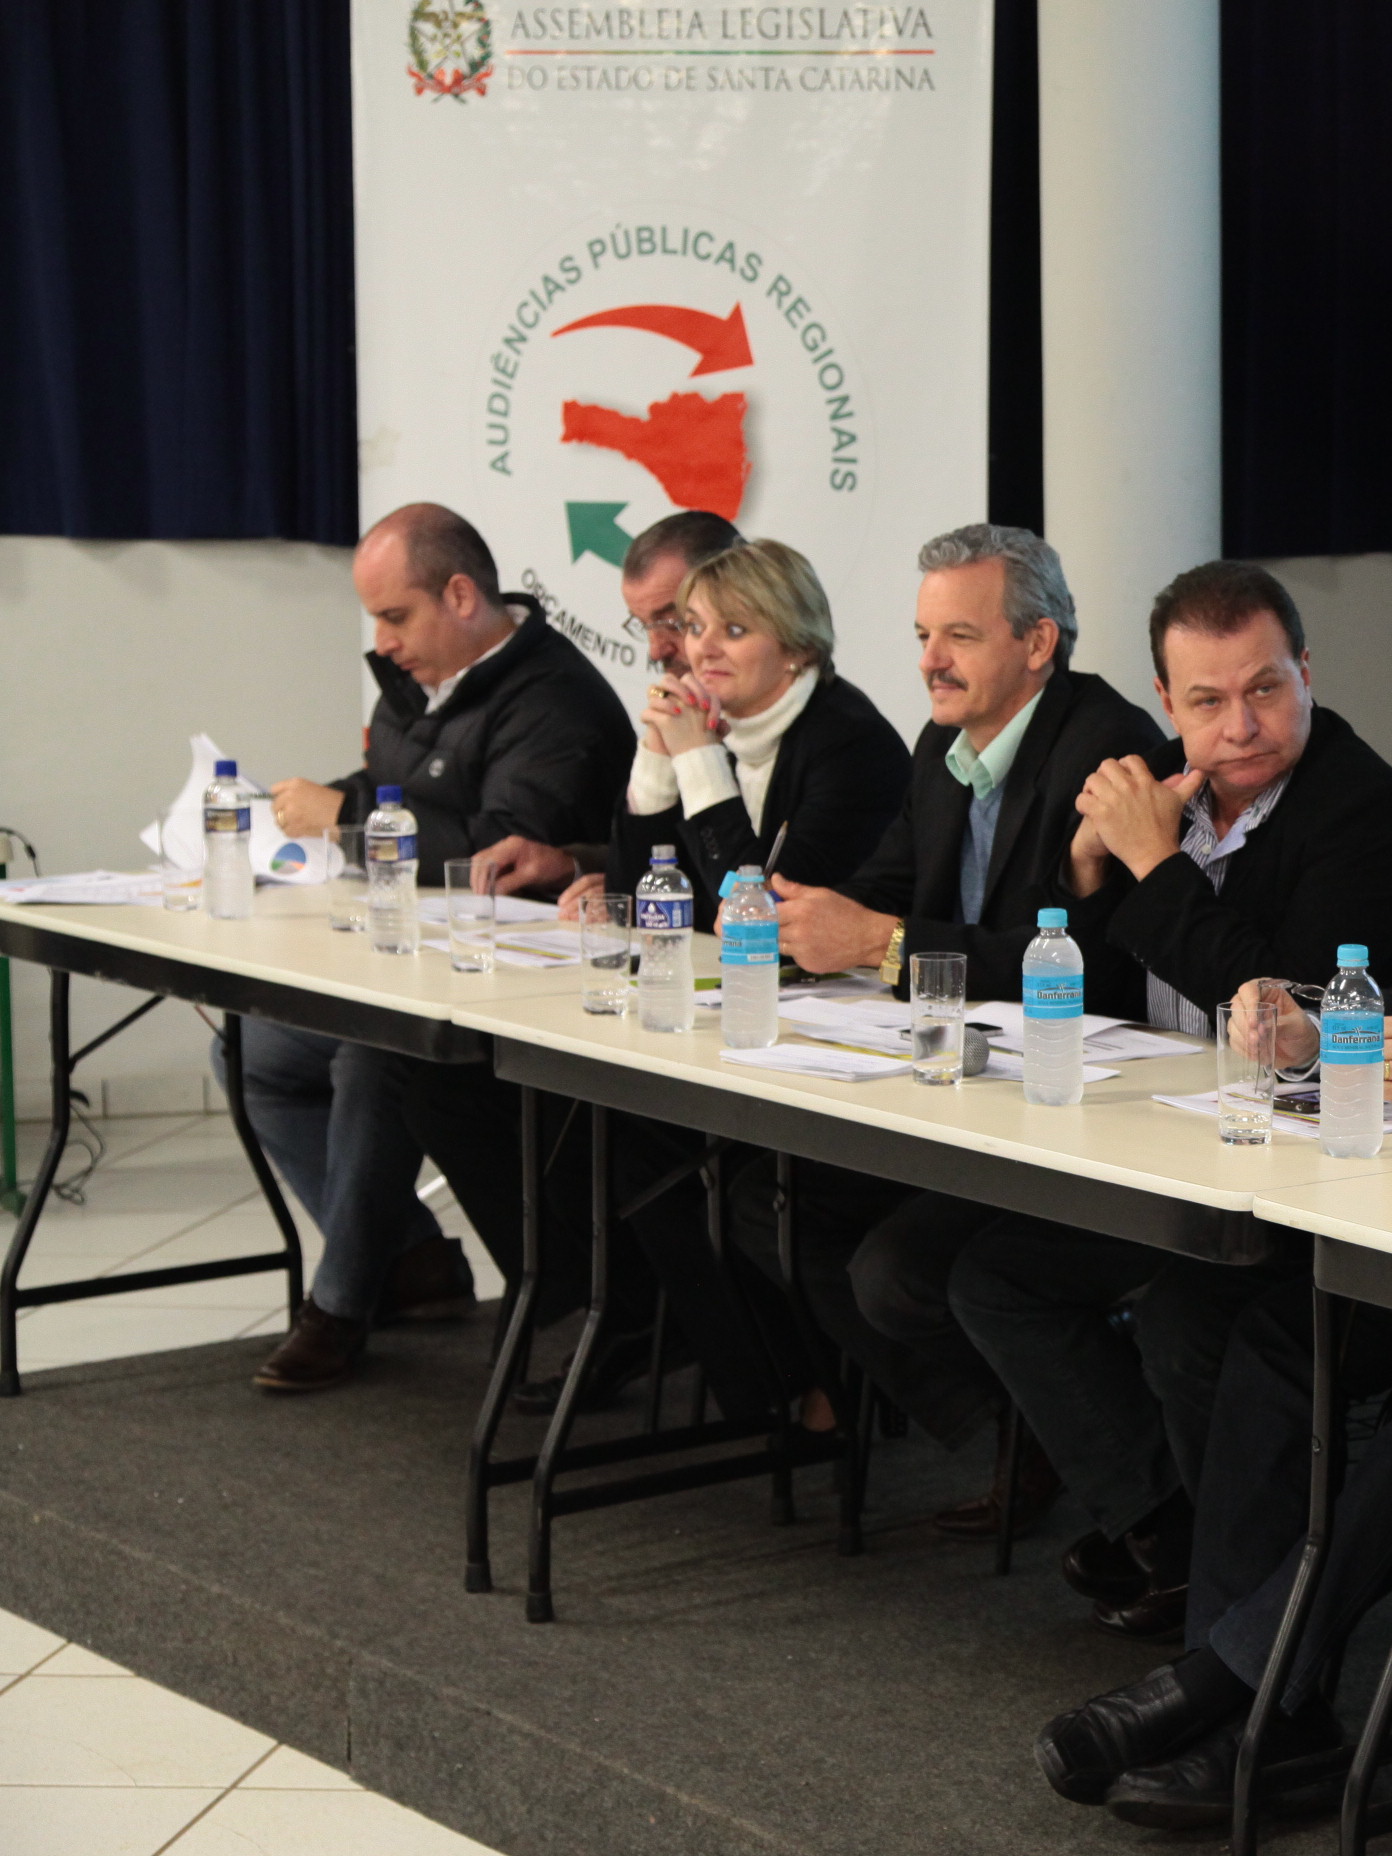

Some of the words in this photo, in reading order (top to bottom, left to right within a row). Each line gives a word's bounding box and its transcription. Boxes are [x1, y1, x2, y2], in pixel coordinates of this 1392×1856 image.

[511, 7, 707, 41] ASSEMBLEIA
[721, 6, 934, 41] LEGISLATIVA
[507, 65, 548, 92] DO
[557, 65, 655, 92] ESTADO
[664, 65, 697, 92] DE
[706, 65, 792, 93] SANTA
[799, 65, 936, 93] CATARINA
[486, 255, 583, 476] AUDIÊNCIAS
[587, 222, 764, 284] PÚBLICAS
[766, 274, 860, 494] REGIONAIS
[1332, 1034, 1380, 1043] Danferrana
